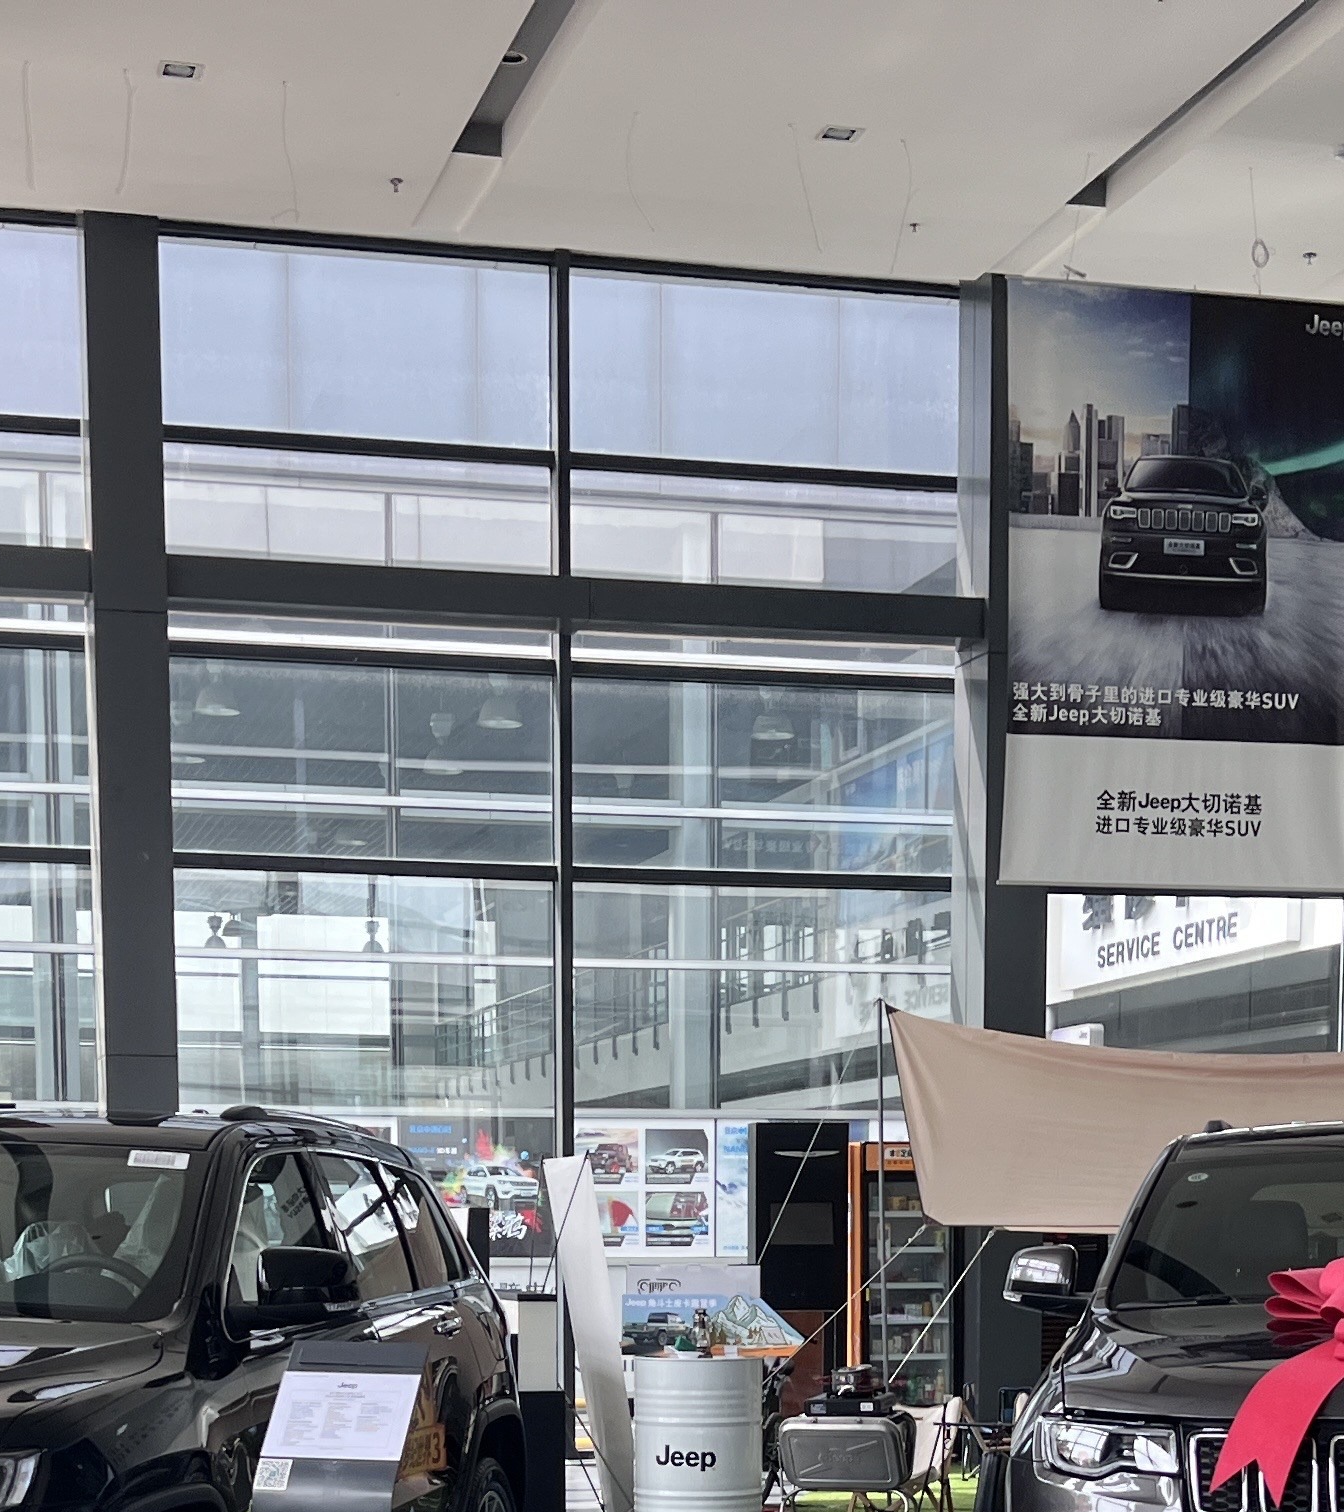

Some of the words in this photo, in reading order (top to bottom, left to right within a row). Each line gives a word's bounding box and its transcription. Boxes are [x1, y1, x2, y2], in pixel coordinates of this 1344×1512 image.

[1012, 681, 1299, 711] 强大到骨子里的进口专业级豪华SUV
[1012, 703, 1162, 727] 全新Jeep大切诺基
[1096, 790, 1263, 816] 全新Jeep大切诺基
[1095, 815, 1262, 838] 进口专业级豪华SUV
[1097, 931, 1161, 969] SERVICE
[1172, 912, 1238, 950] CENTRE
[656, 1445, 716, 1471] Jeep
